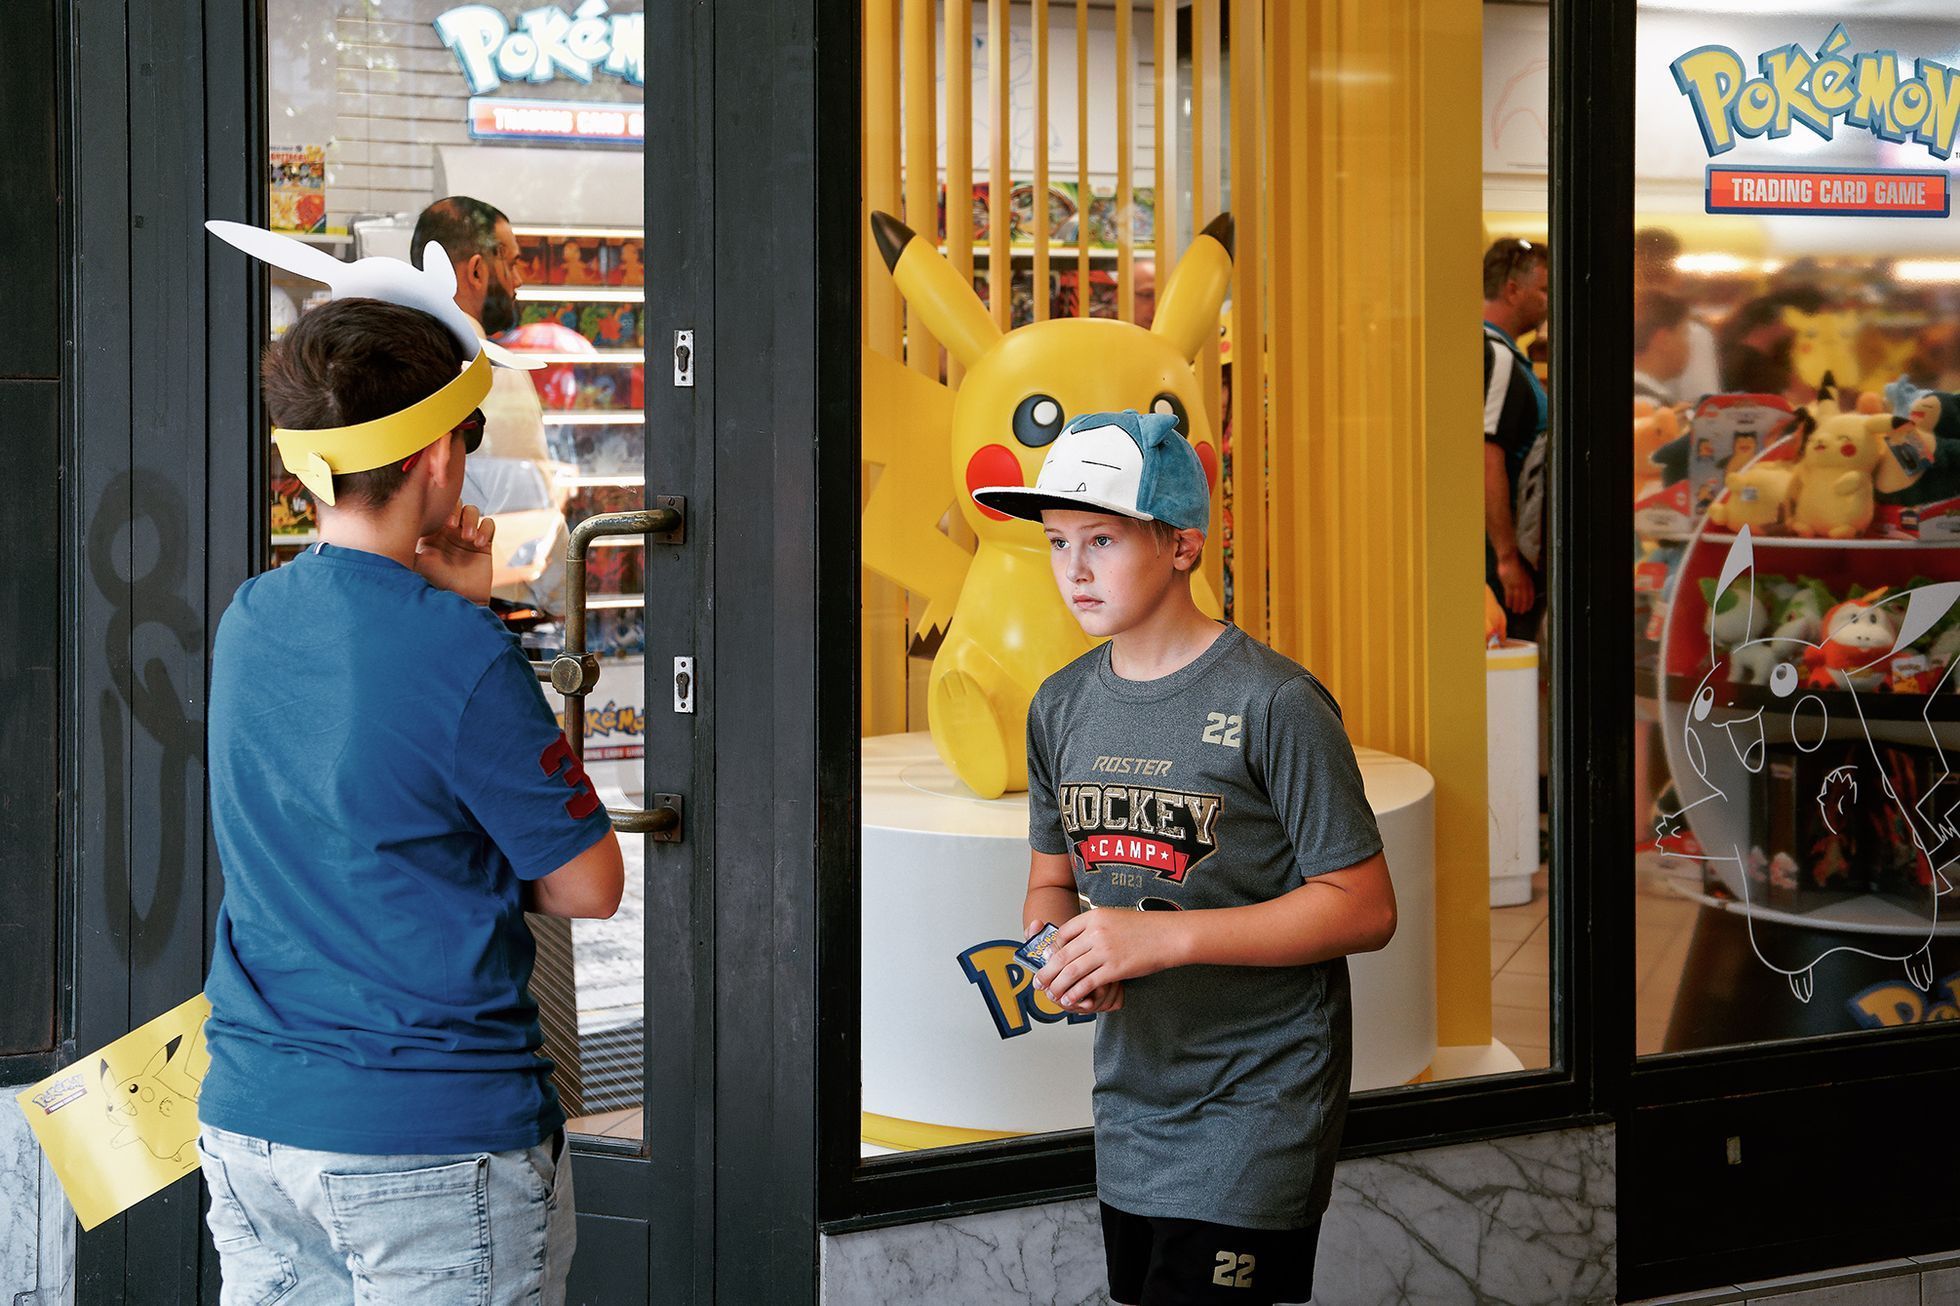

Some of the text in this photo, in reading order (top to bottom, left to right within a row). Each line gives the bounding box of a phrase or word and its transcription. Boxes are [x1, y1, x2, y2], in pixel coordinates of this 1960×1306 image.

[1731, 177, 1926, 205] TRADING CARD GAME
[1202, 712, 1242, 748] 22
[1092, 755, 1173, 777] ROSTER
[1060, 785, 1220, 846] HOCKEY
[1099, 839, 1157, 861] CAMP
[1213, 1250, 1256, 1288] 22
